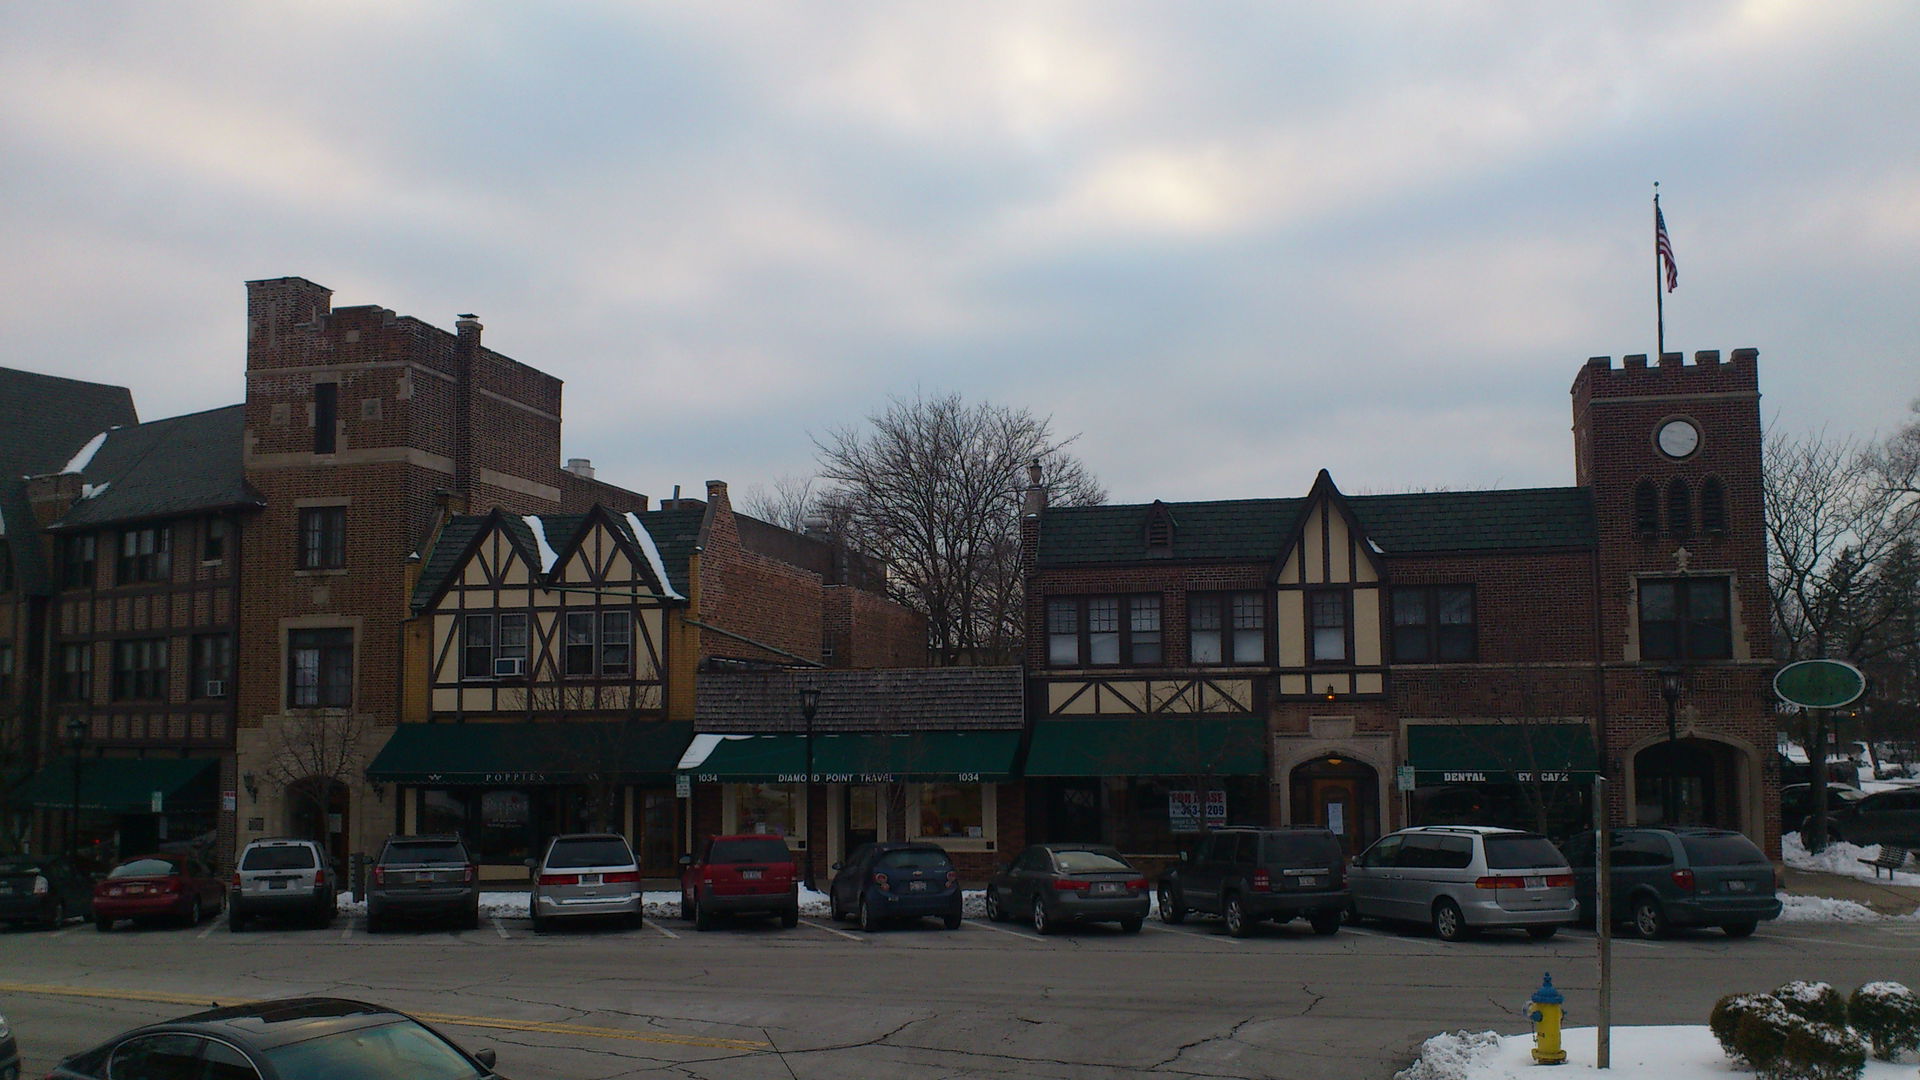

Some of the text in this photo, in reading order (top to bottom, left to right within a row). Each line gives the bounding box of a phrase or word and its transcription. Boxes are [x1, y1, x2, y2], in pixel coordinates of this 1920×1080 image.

[485, 773, 545, 781] POPPIES
[698, 774, 718, 782] 1034
[825, 773, 854, 782] POINT
[860, 773, 894, 782] TRAVEL
[959, 773, 979, 781] 1034
[1443, 772, 1486, 782] DENTAL
